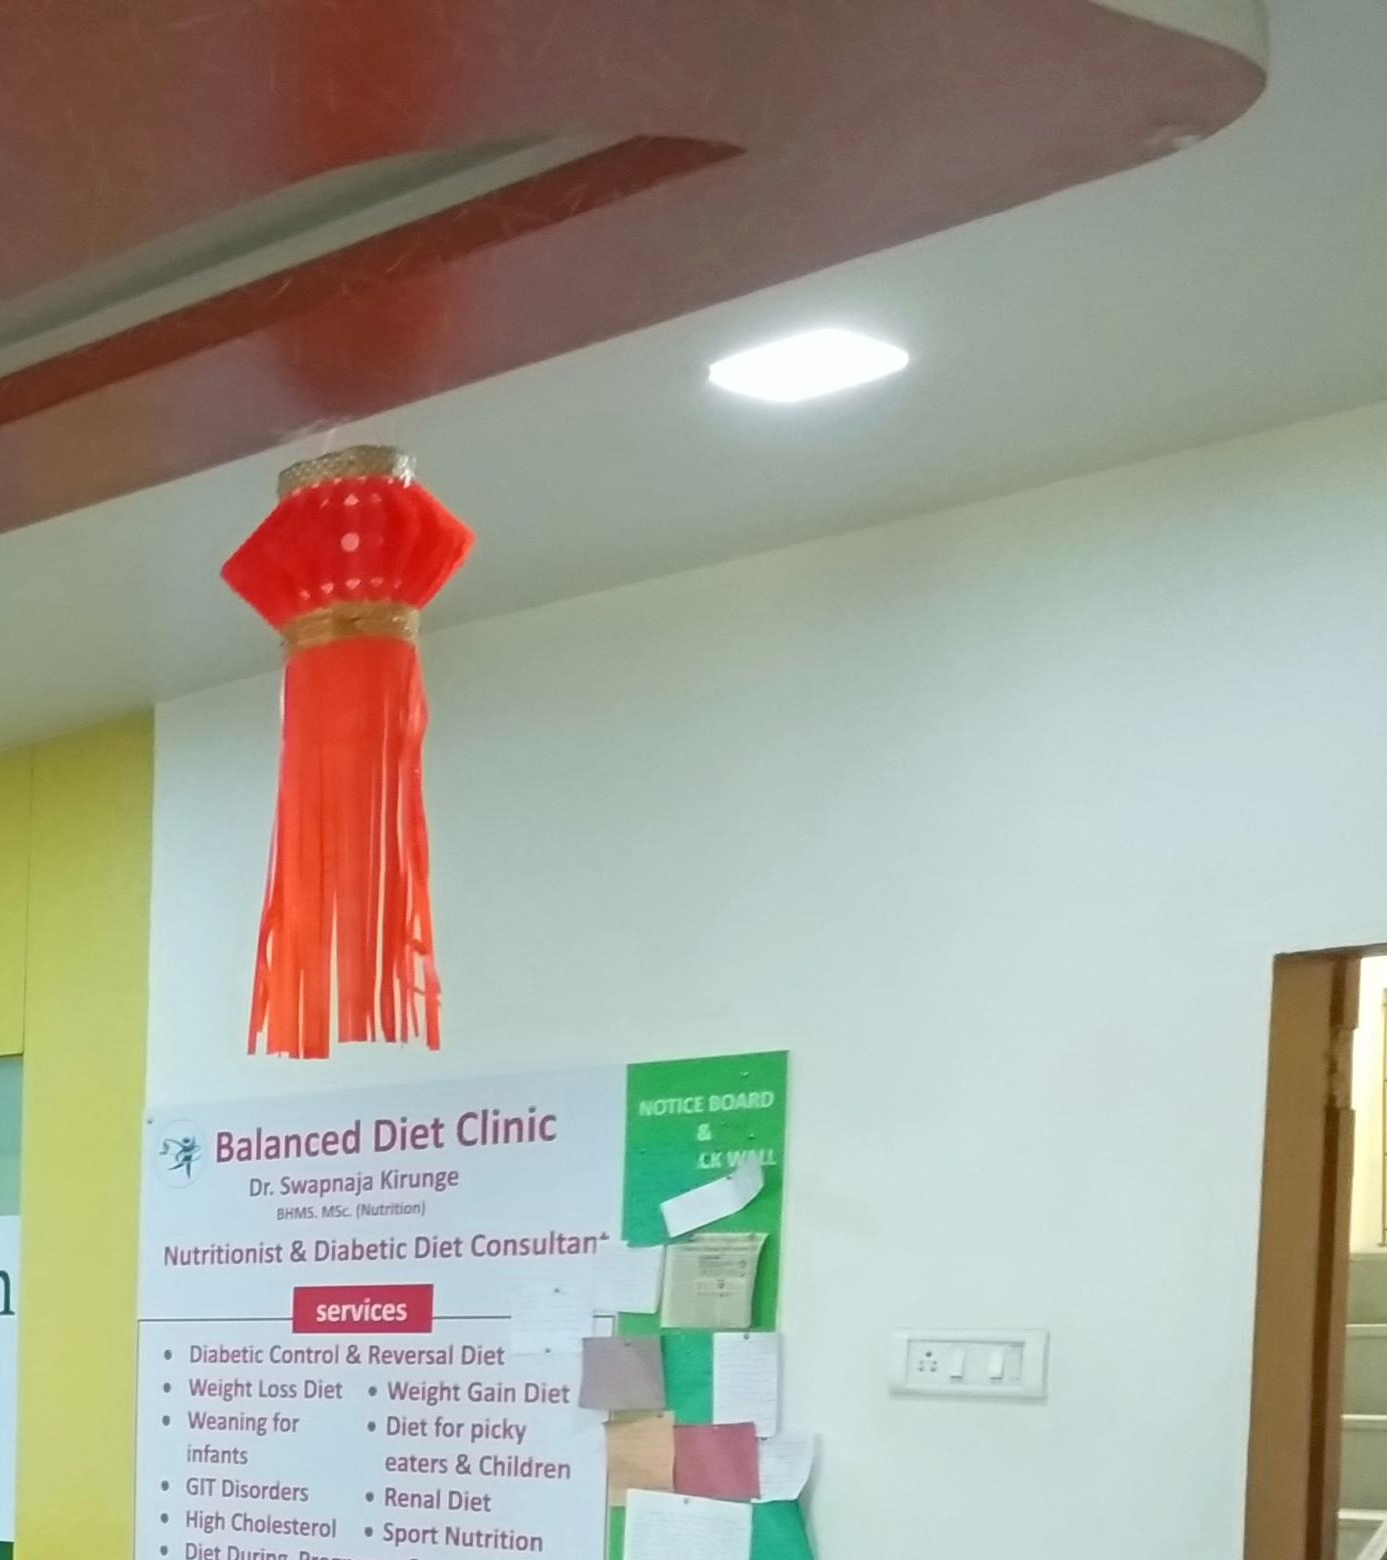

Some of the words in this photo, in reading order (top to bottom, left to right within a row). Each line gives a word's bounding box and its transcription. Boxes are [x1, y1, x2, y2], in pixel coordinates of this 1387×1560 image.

[639, 1097, 703, 1116] NOTICE
[709, 1091, 774, 1112] BOARD
[216, 1120, 361, 1163] Balanced
[374, 1117, 445, 1153] Diet
[456, 1107, 557, 1148] Clinic
[249, 1177, 274, 1197] Dr.
[280, 1174, 373, 1197] Swapnaja
[381, 1168, 459, 1192] Kirunge
[355, 1201, 426, 1219] (Nutrition)
[164, 1243, 283, 1266] Nutritionist
[290, 1241, 307, 1263] &
[314, 1237, 407, 1262] Diabetic
[414, 1234, 462, 1259] Diet
[316, 1297, 407, 1322] services
[190, 1345, 263, 1365] Diabetic
[270, 1345, 340, 1365] Control
[346, 1346, 362, 1365] &
[368, 1346, 454, 1365] Reversal
[461, 1346, 505, 1365] Diet
[189, 1379, 254, 1401] Weight
[258, 1380, 297, 1398] Loss
[304, 1380, 343, 1400] Diet
[387, 1382, 461, 1406] Weight
[467, 1383, 516, 1403] Gain
[524, 1384, 571, 1404] Diet
[188, 1412, 266, 1436] Weaning
[273, 1413, 300, 1432] for
[386, 1416, 427, 1437] Diet
[434, 1417, 465, 1438] for
[470, 1419, 527, 1445] picky
[187, 1444, 248, 1465] infants
[385, 1457, 448, 1474] eaters
[455, 1455, 471, 1475] &
[478, 1455, 571, 1480] Children
[186, 1478, 216, 1497] GIT
[221, 1479, 309, 1502] Disorders
[384, 1488, 442, 1510] Renal
[448, 1489, 492, 1512] Diet
[185, 1510, 225, 1535] High
[231, 1512, 337, 1538] Cholesterol
[382, 1522, 438, 1546] Sport
[445, 1527, 543, 1552] Nutrition
